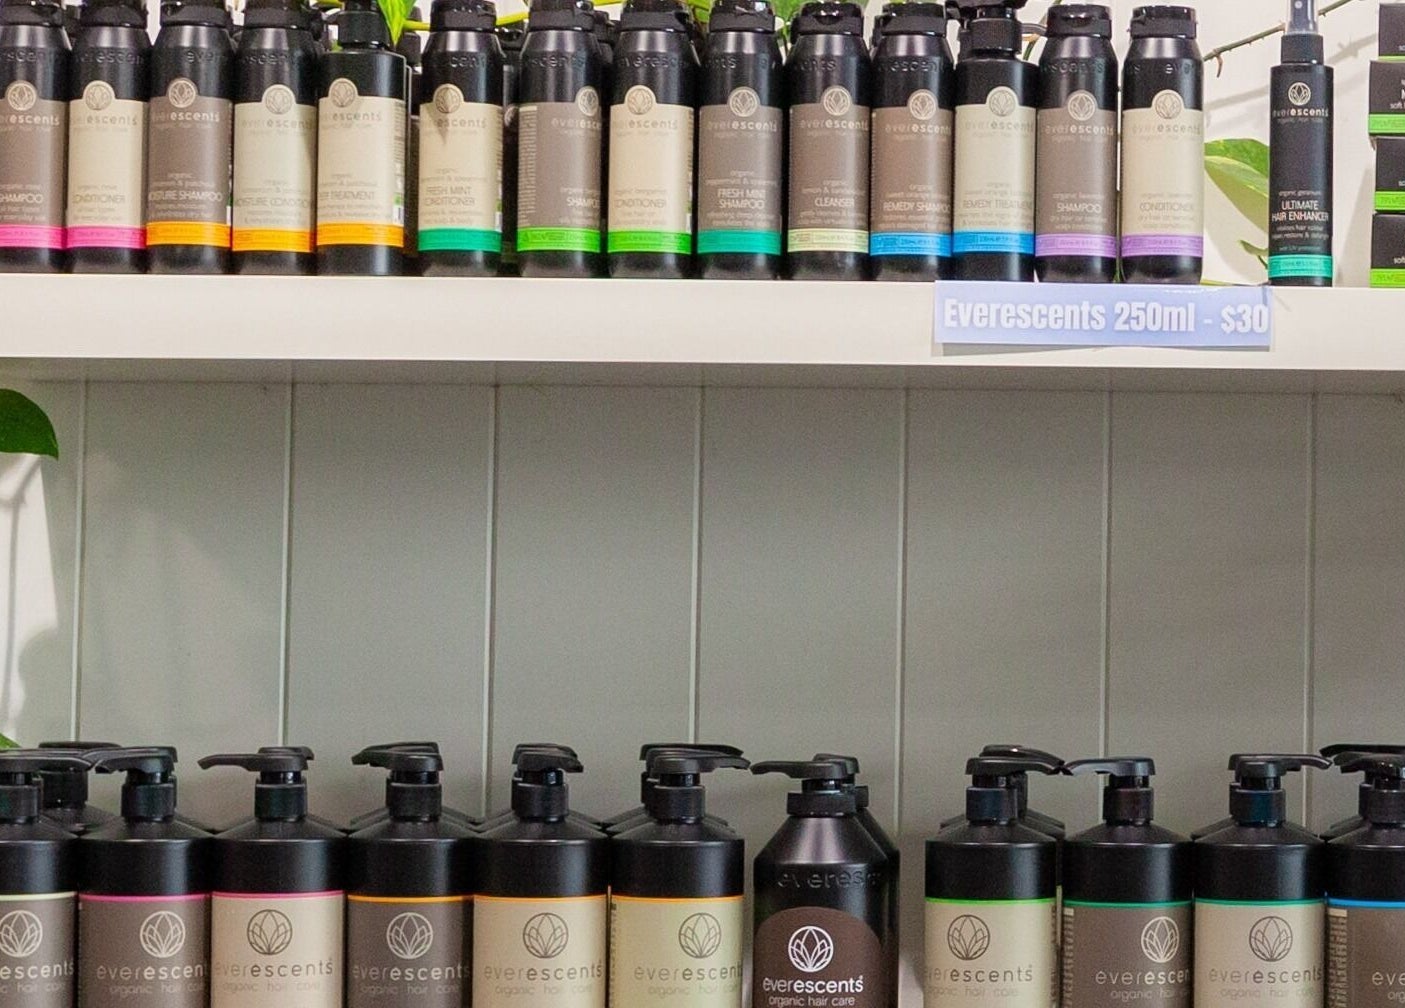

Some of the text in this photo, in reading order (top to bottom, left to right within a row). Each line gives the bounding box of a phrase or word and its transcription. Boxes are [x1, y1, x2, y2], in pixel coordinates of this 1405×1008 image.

[1281, 200, 1319, 211] ULTIMATE
[1272, 212, 1329, 222] HAIR ENHANCER
[944, 299, 1106, 332] Everescents
[1114, 303, 1195, 333] 250ml
[1221, 305, 1269, 336] $30
[763, 974, 865, 995] everescents
[768, 994, 856, 1008] organic hair care
